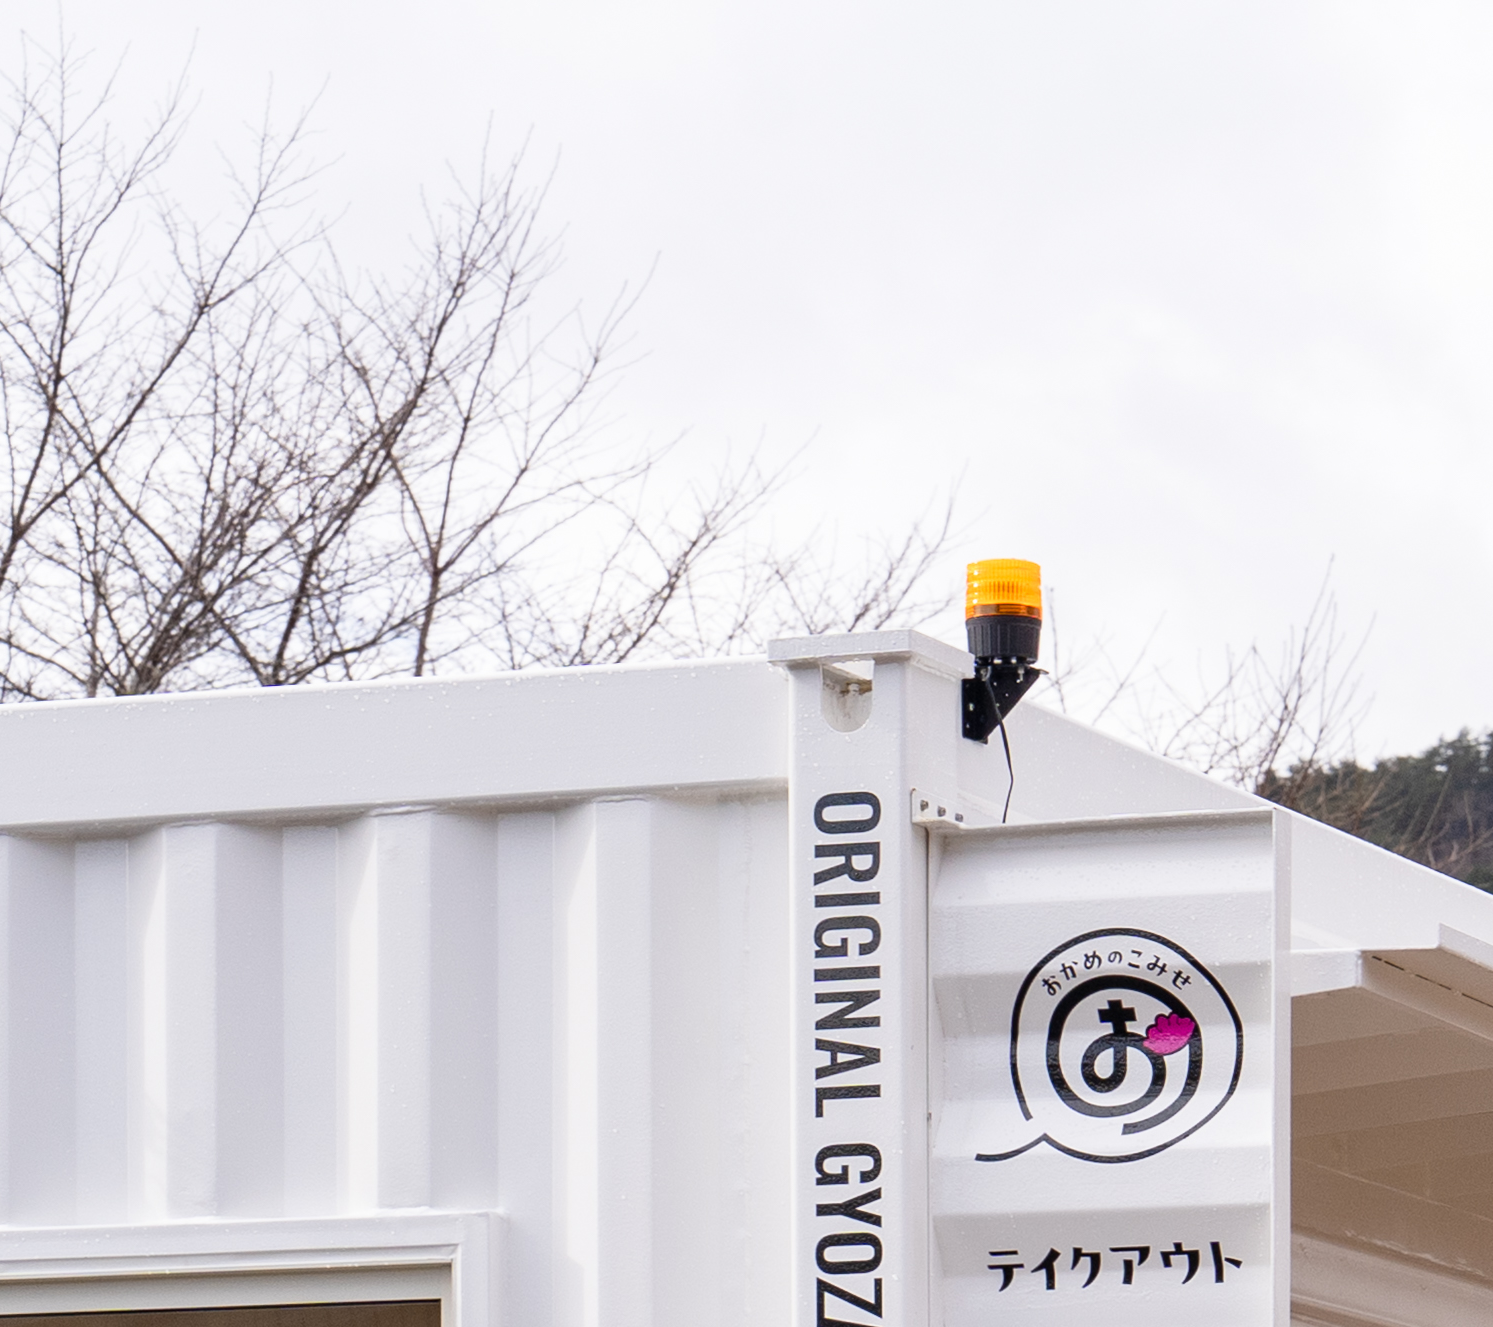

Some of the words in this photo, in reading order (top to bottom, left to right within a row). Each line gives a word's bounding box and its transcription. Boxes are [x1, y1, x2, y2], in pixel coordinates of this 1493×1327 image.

[813, 791, 882, 1118] ORIGINAL
[1041, 949, 1192, 994] おかめのこみせ
[987, 1240, 1244, 1292] テイクアウト
